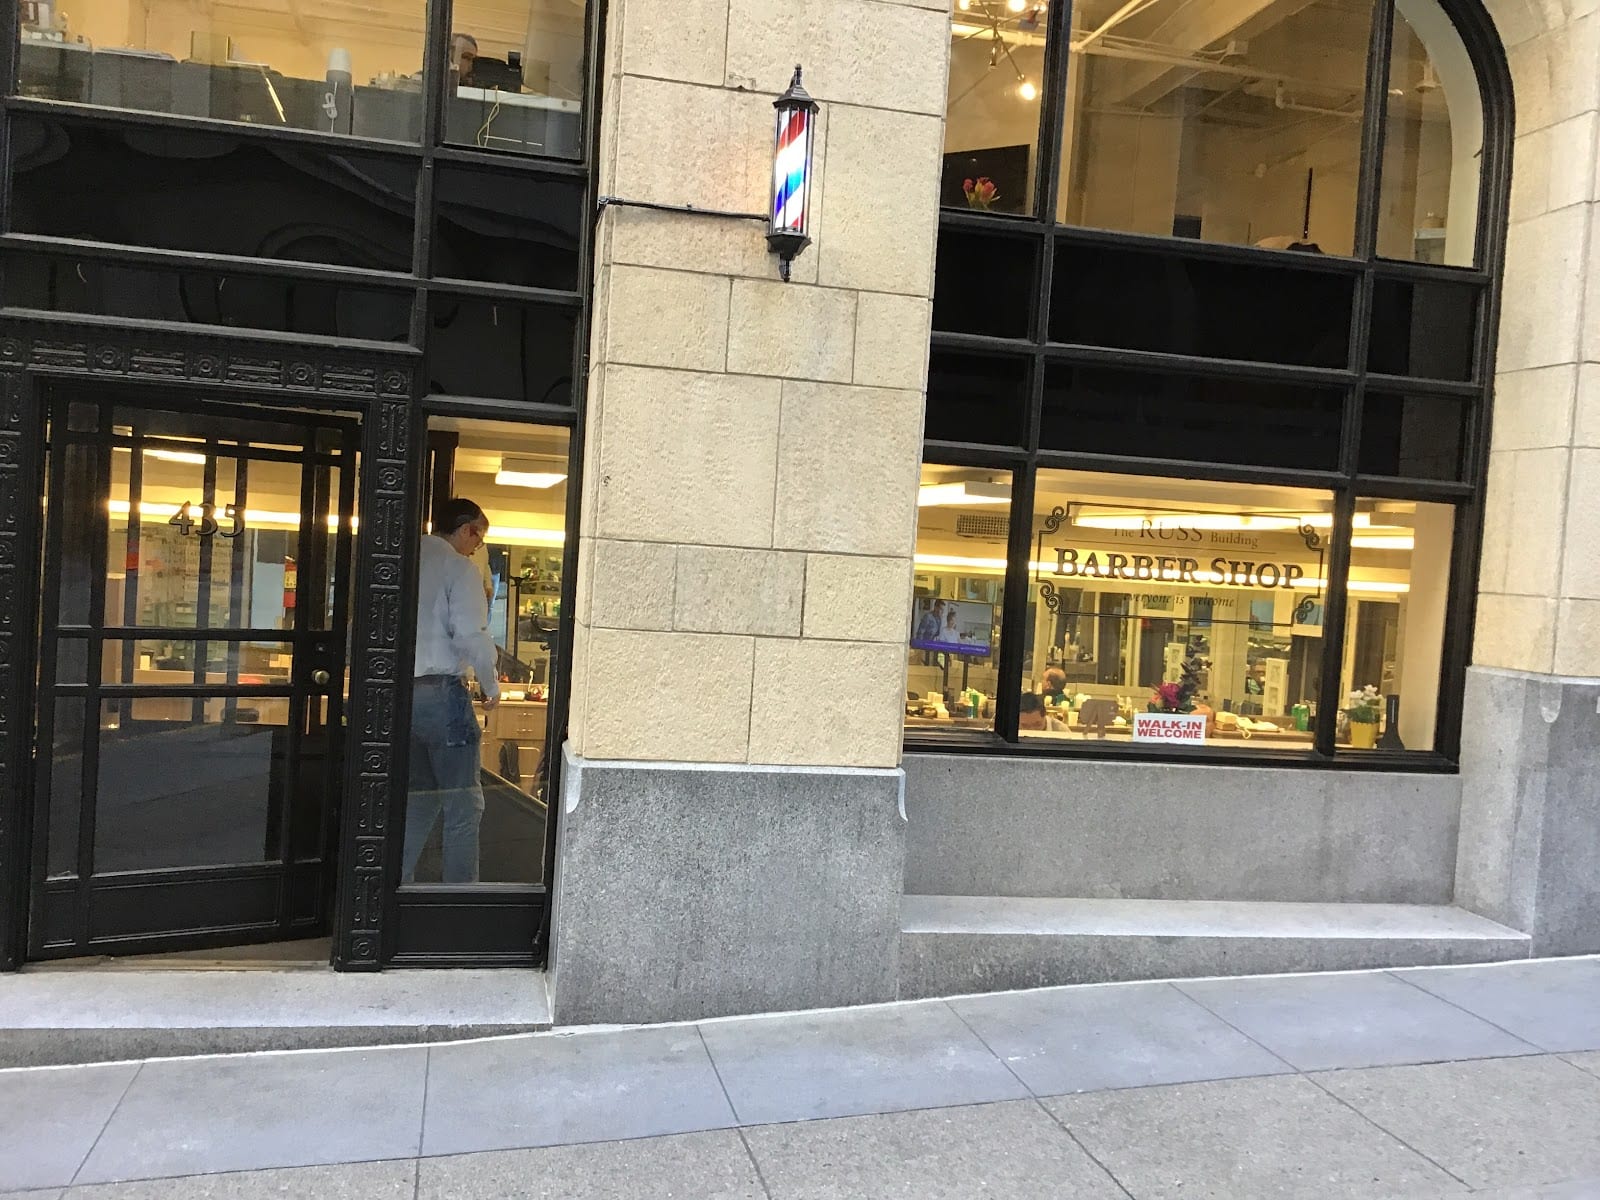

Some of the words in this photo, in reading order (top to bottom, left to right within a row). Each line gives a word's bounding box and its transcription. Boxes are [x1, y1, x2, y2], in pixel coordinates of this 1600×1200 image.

[168, 500, 246, 537] 435
[1139, 519, 1203, 541] RUSS
[1210, 531, 1259, 549] Building
[1053, 548, 1200, 583] BARBER
[1208, 557, 1304, 589] SHOP
[1176, 593, 1185, 605] is
[1137, 719, 1203, 730] WALK-IN
[1137, 728, 1202, 739] WELCOME
